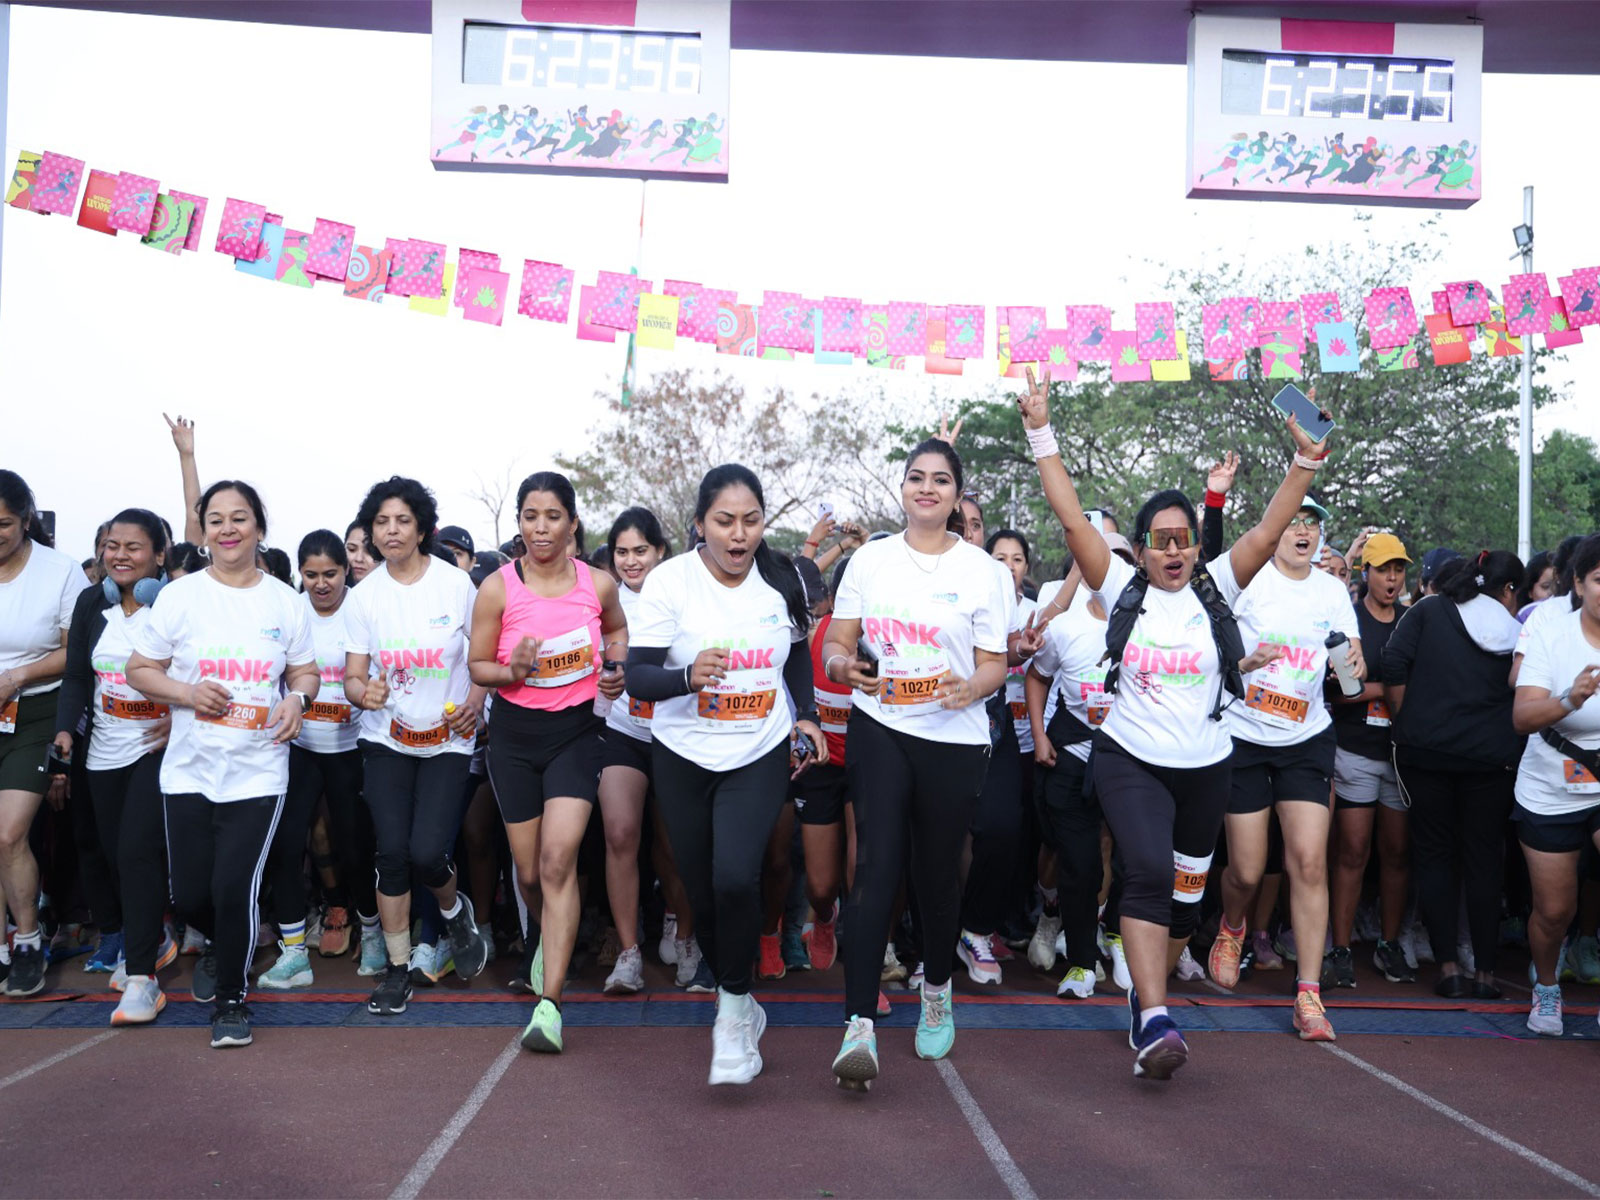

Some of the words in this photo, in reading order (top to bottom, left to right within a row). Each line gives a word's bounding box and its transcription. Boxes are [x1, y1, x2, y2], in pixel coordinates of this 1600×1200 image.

[502, 27, 703, 94] 6:23:56
[1260, 59, 1455, 122] 6:23:55
[865, 617, 942, 649] PINK
[379, 647, 445, 670] PINK
[546, 651, 581, 670] 10186
[1123, 641, 1203, 675] PINK
[198, 658, 273, 683] PINK
[901, 678, 939, 695] 10272
[120, 701, 155, 713] 10058
[725, 694, 763, 710] 10727
[1268, 693, 1298, 711] 10710
